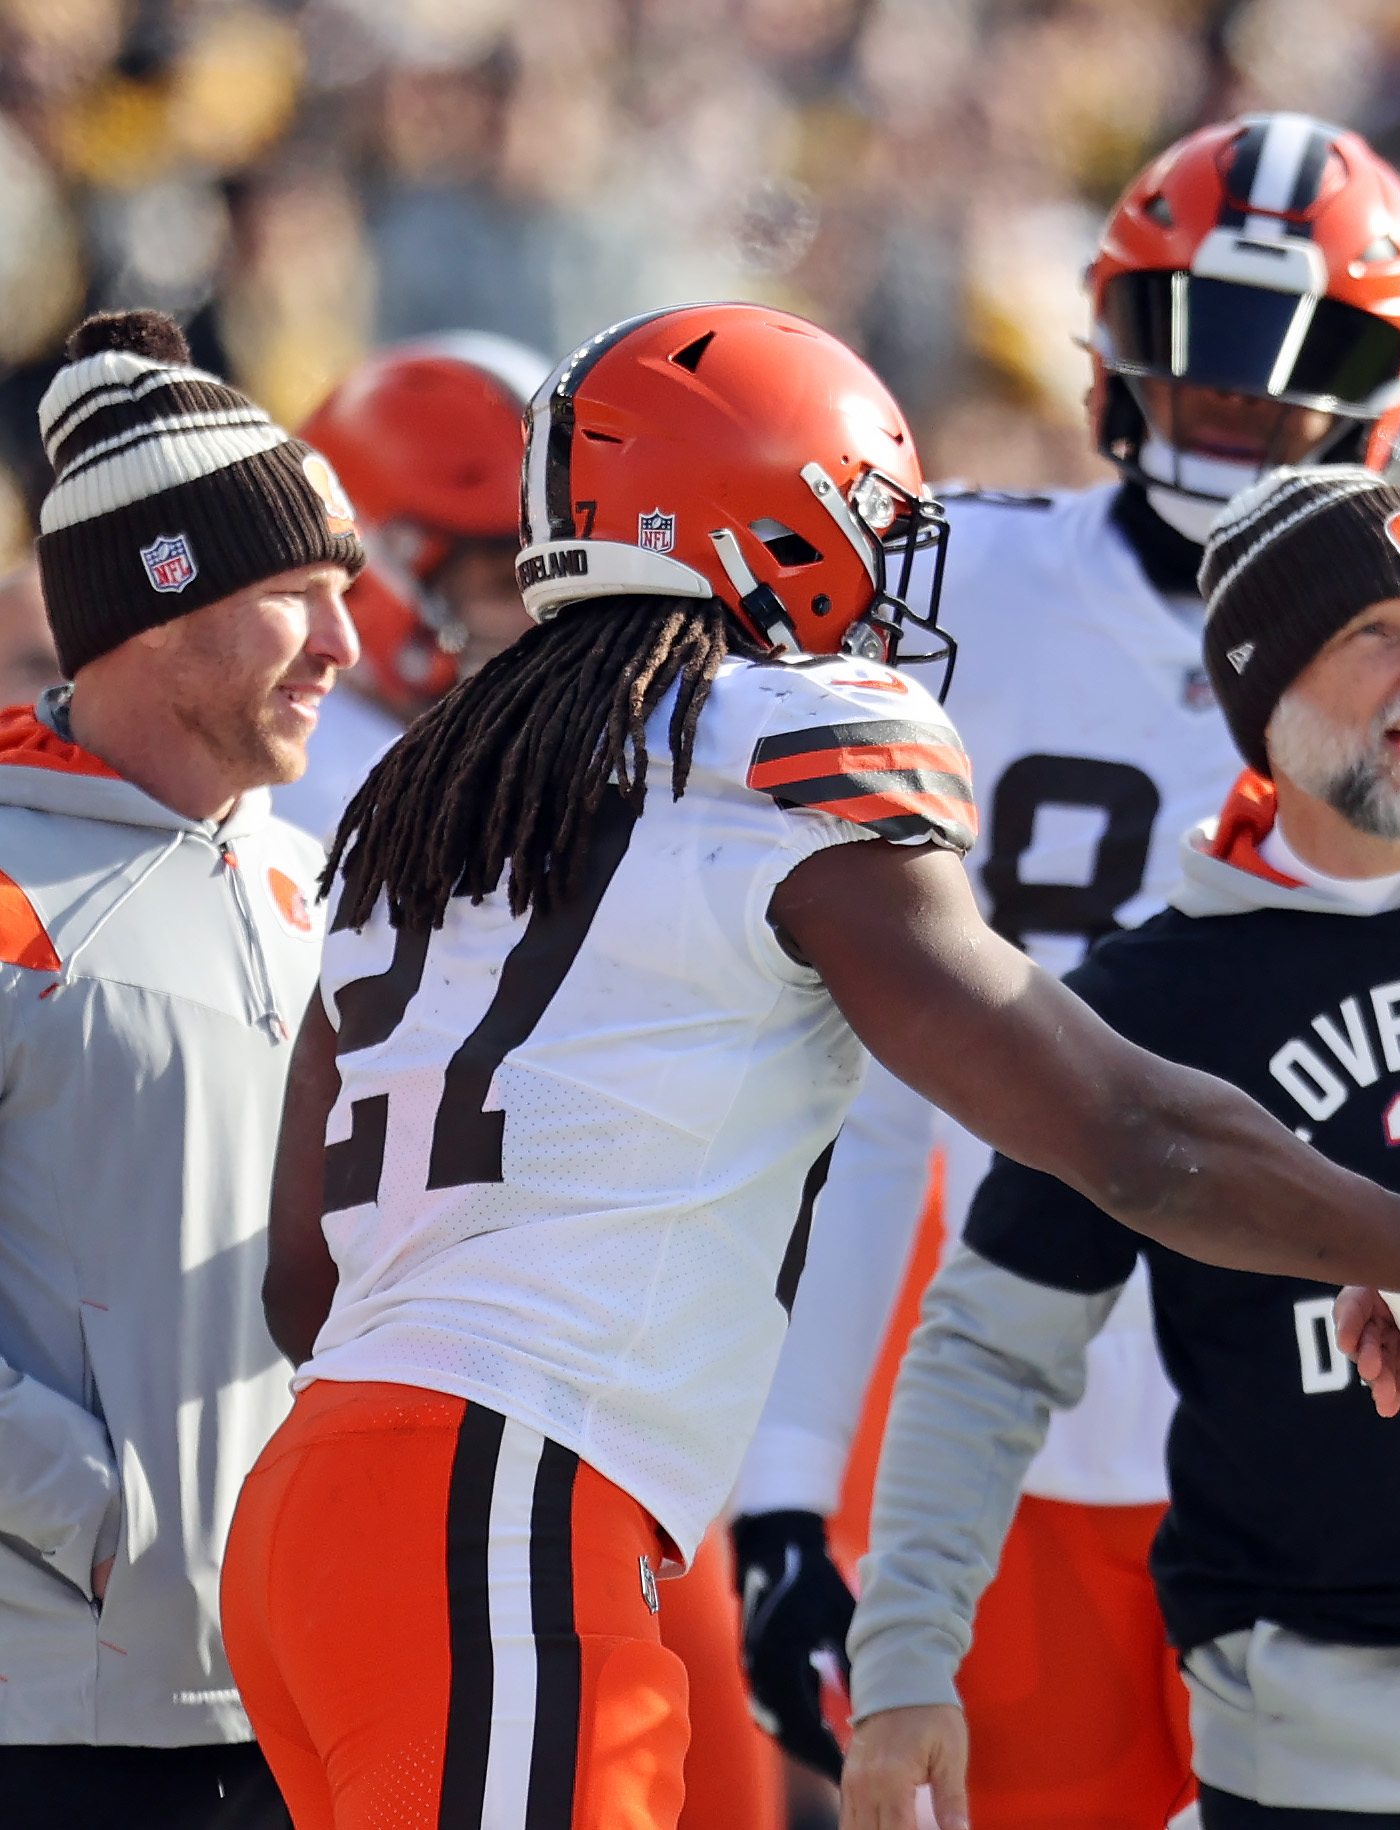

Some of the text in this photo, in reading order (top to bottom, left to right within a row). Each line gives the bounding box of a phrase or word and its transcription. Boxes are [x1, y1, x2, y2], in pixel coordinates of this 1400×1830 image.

[575, 500, 597, 540] 7
[643, 532, 669, 551] NFL
[153, 558, 192, 585] NFL
